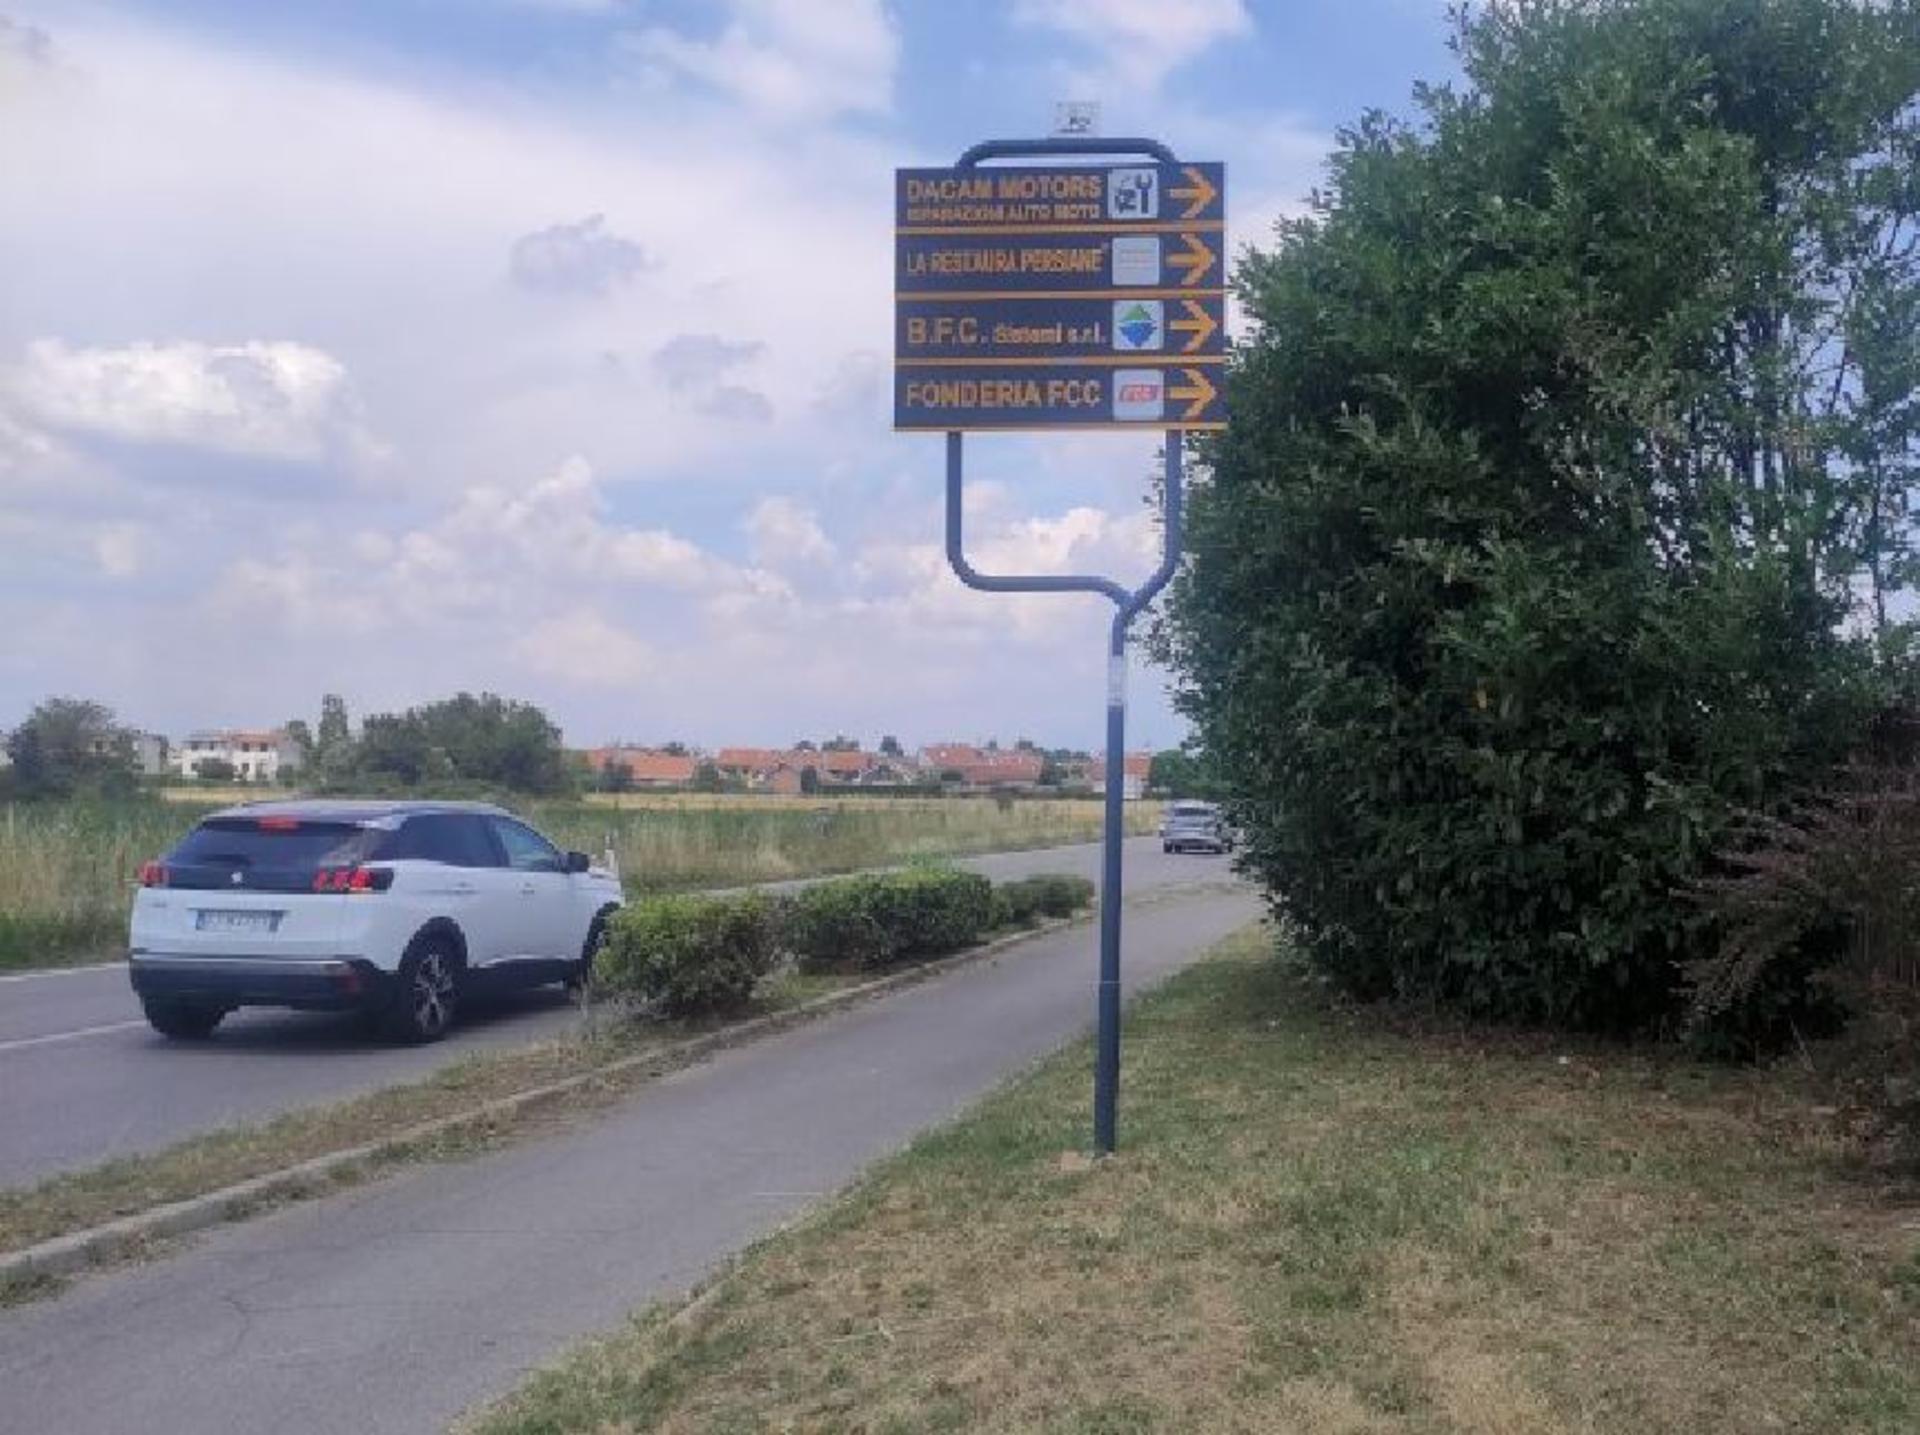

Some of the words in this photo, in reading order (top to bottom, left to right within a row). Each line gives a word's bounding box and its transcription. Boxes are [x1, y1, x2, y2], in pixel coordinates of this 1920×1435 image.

[999, 176, 1101, 199] MOTORS
[1009, 203, 1051, 220] AUTO
[1054, 203, 1100, 219] MOTO
[906, 252, 926, 275] LA
[1021, 248, 1102, 273] PERSIANE
[907, 318, 989, 344] B.F.C.
[906, 380, 1041, 408] FONDERIA
[1047, 380, 1101, 407] FCC
